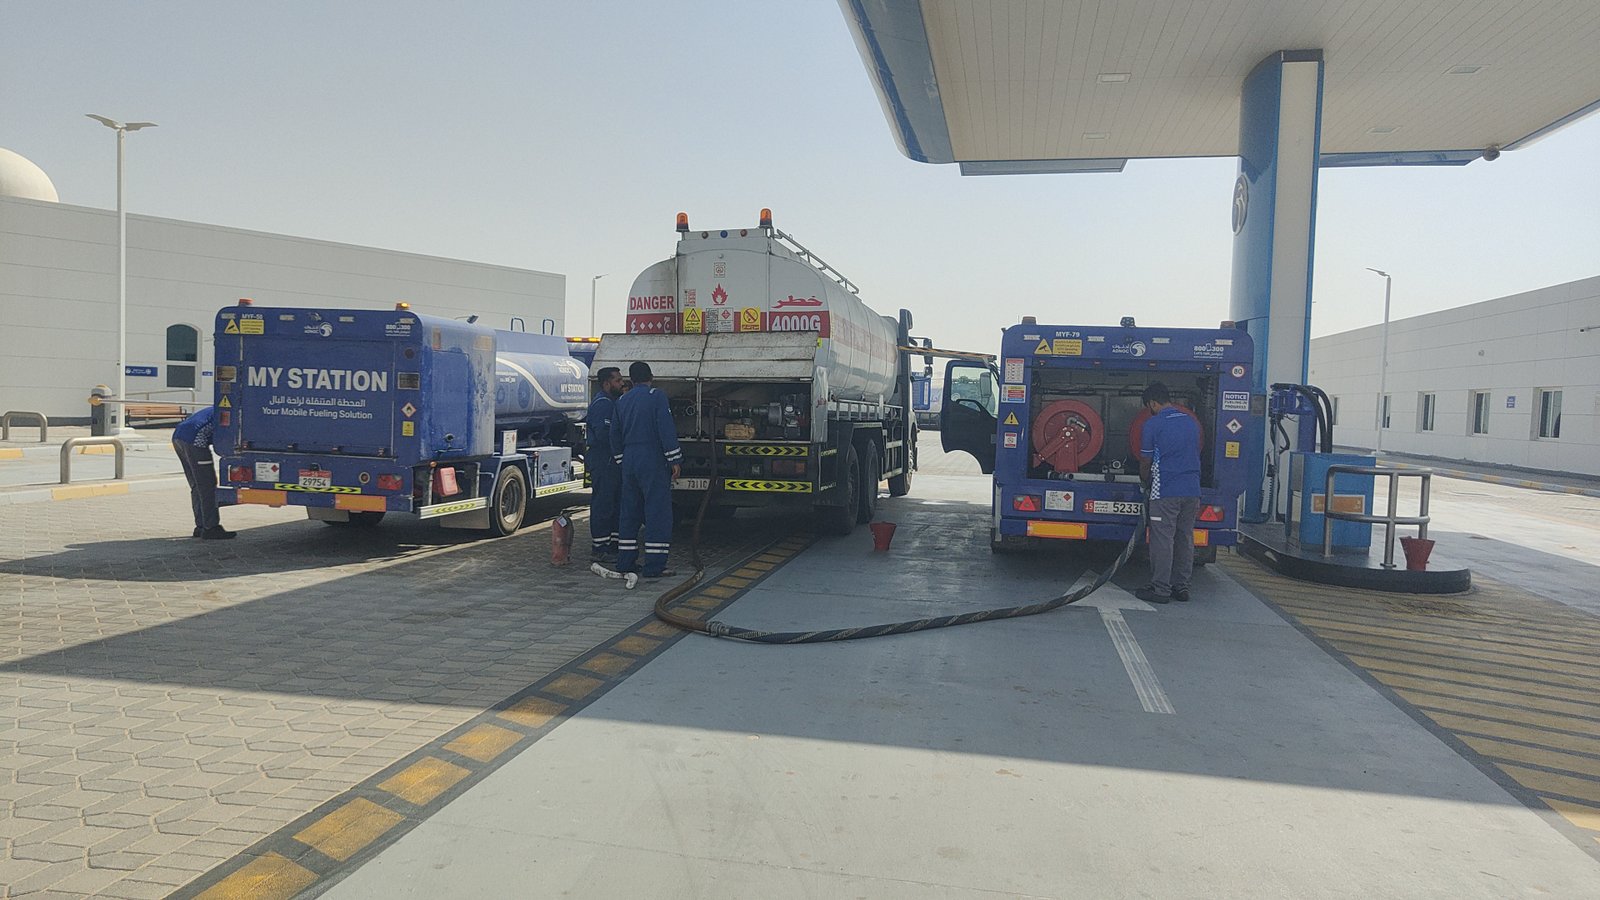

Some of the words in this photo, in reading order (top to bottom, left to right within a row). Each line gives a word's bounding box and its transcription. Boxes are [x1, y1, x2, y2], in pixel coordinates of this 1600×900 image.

[630, 295, 675, 310] DANGER
[771, 295, 823, 308] خطر
[771, 314, 821, 331] 4000G
[248, 366, 283, 387] MY
[287, 367, 388, 392] STATION
[568, 384, 584, 393] STATION
[269, 395, 285, 406] البال
[337, 399, 366, 408] المحطة
[262, 406, 280, 416] Your
[281, 407, 308, 417] Mobile
[309, 408, 338, 420] Fueling
[339, 410, 373, 420] Solution
[302, 478, 326, 487] 29754
[1084, 502, 1094, 510] 15
